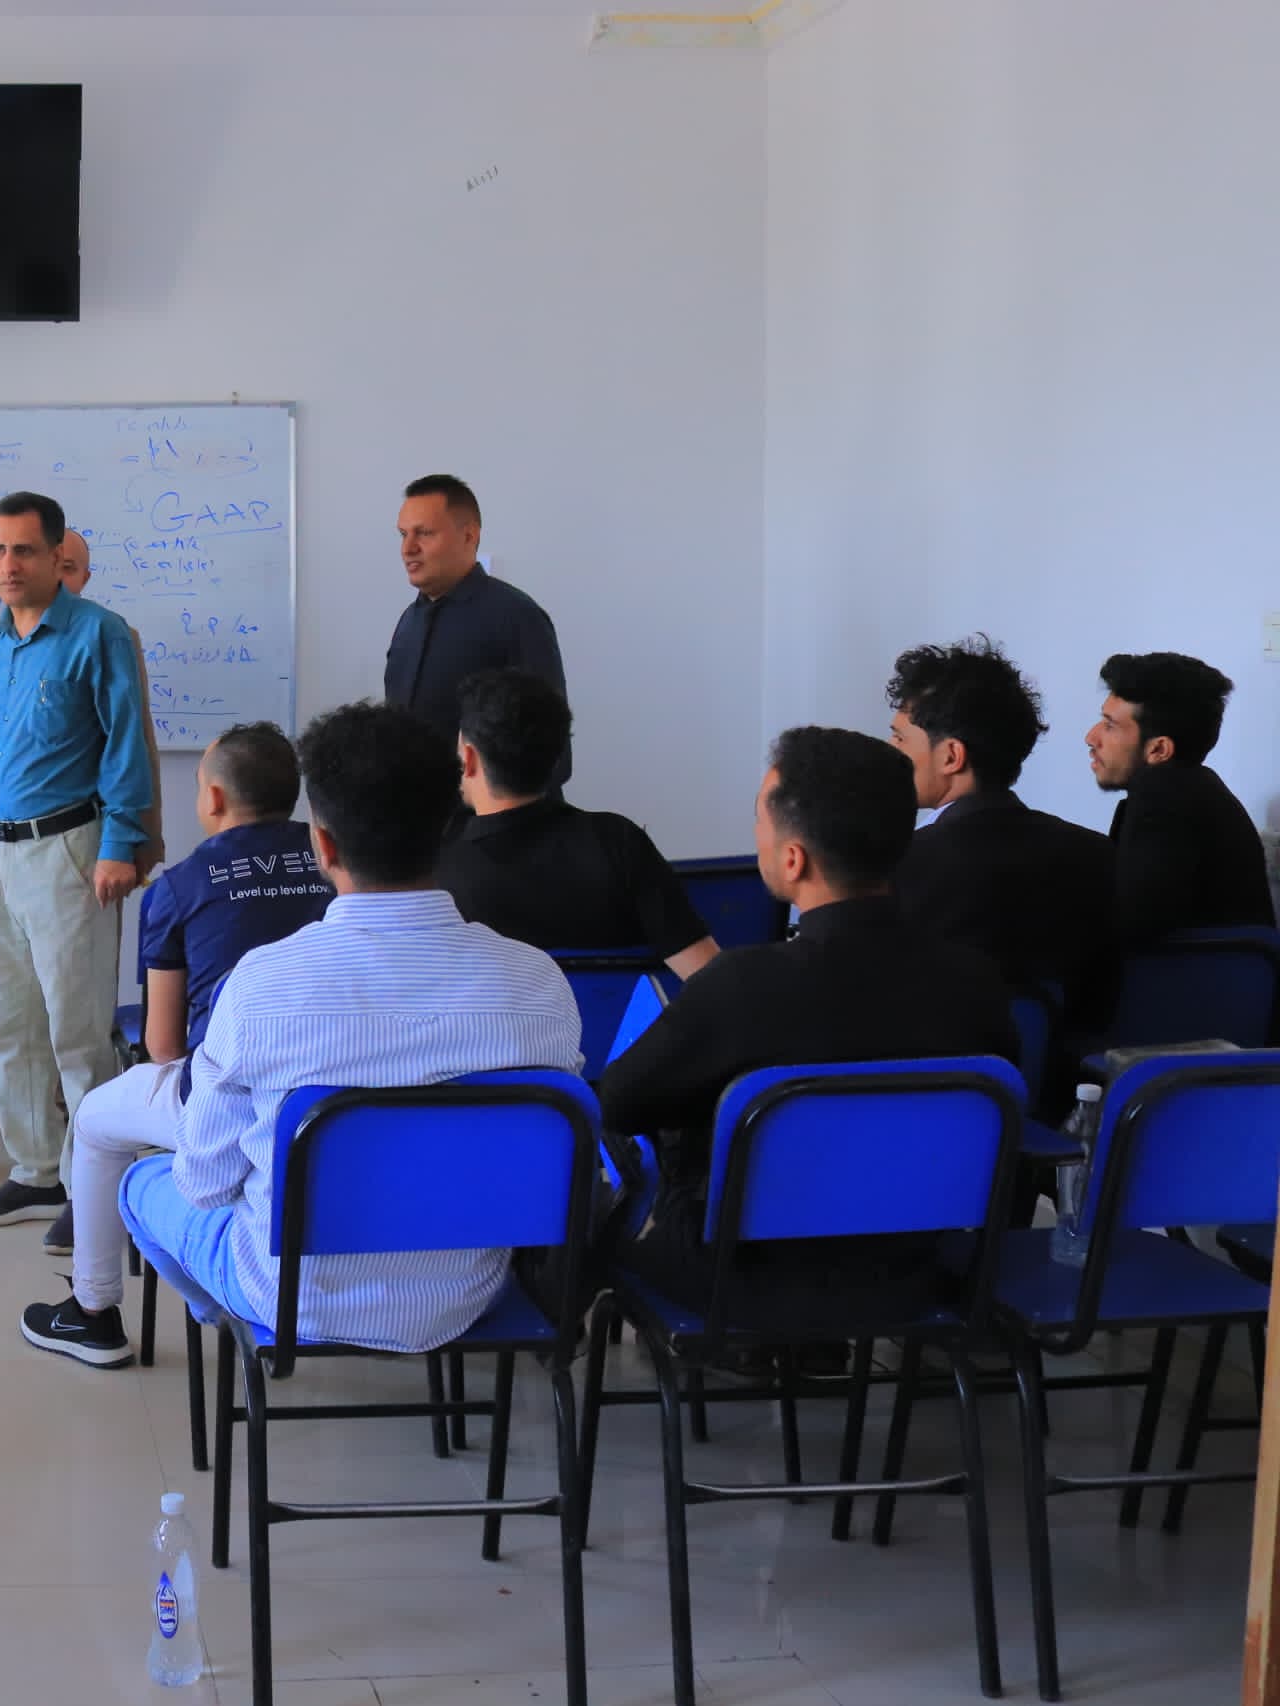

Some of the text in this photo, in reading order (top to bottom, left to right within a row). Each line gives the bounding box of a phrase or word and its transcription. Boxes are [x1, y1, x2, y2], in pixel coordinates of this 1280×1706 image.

[151, 491, 269, 532] GAAP
[208, 851, 320, 884] LEVEL
[229, 885, 261, 901] Level
[264, 886, 278, 898] up
[280, 883, 307, 896] level
